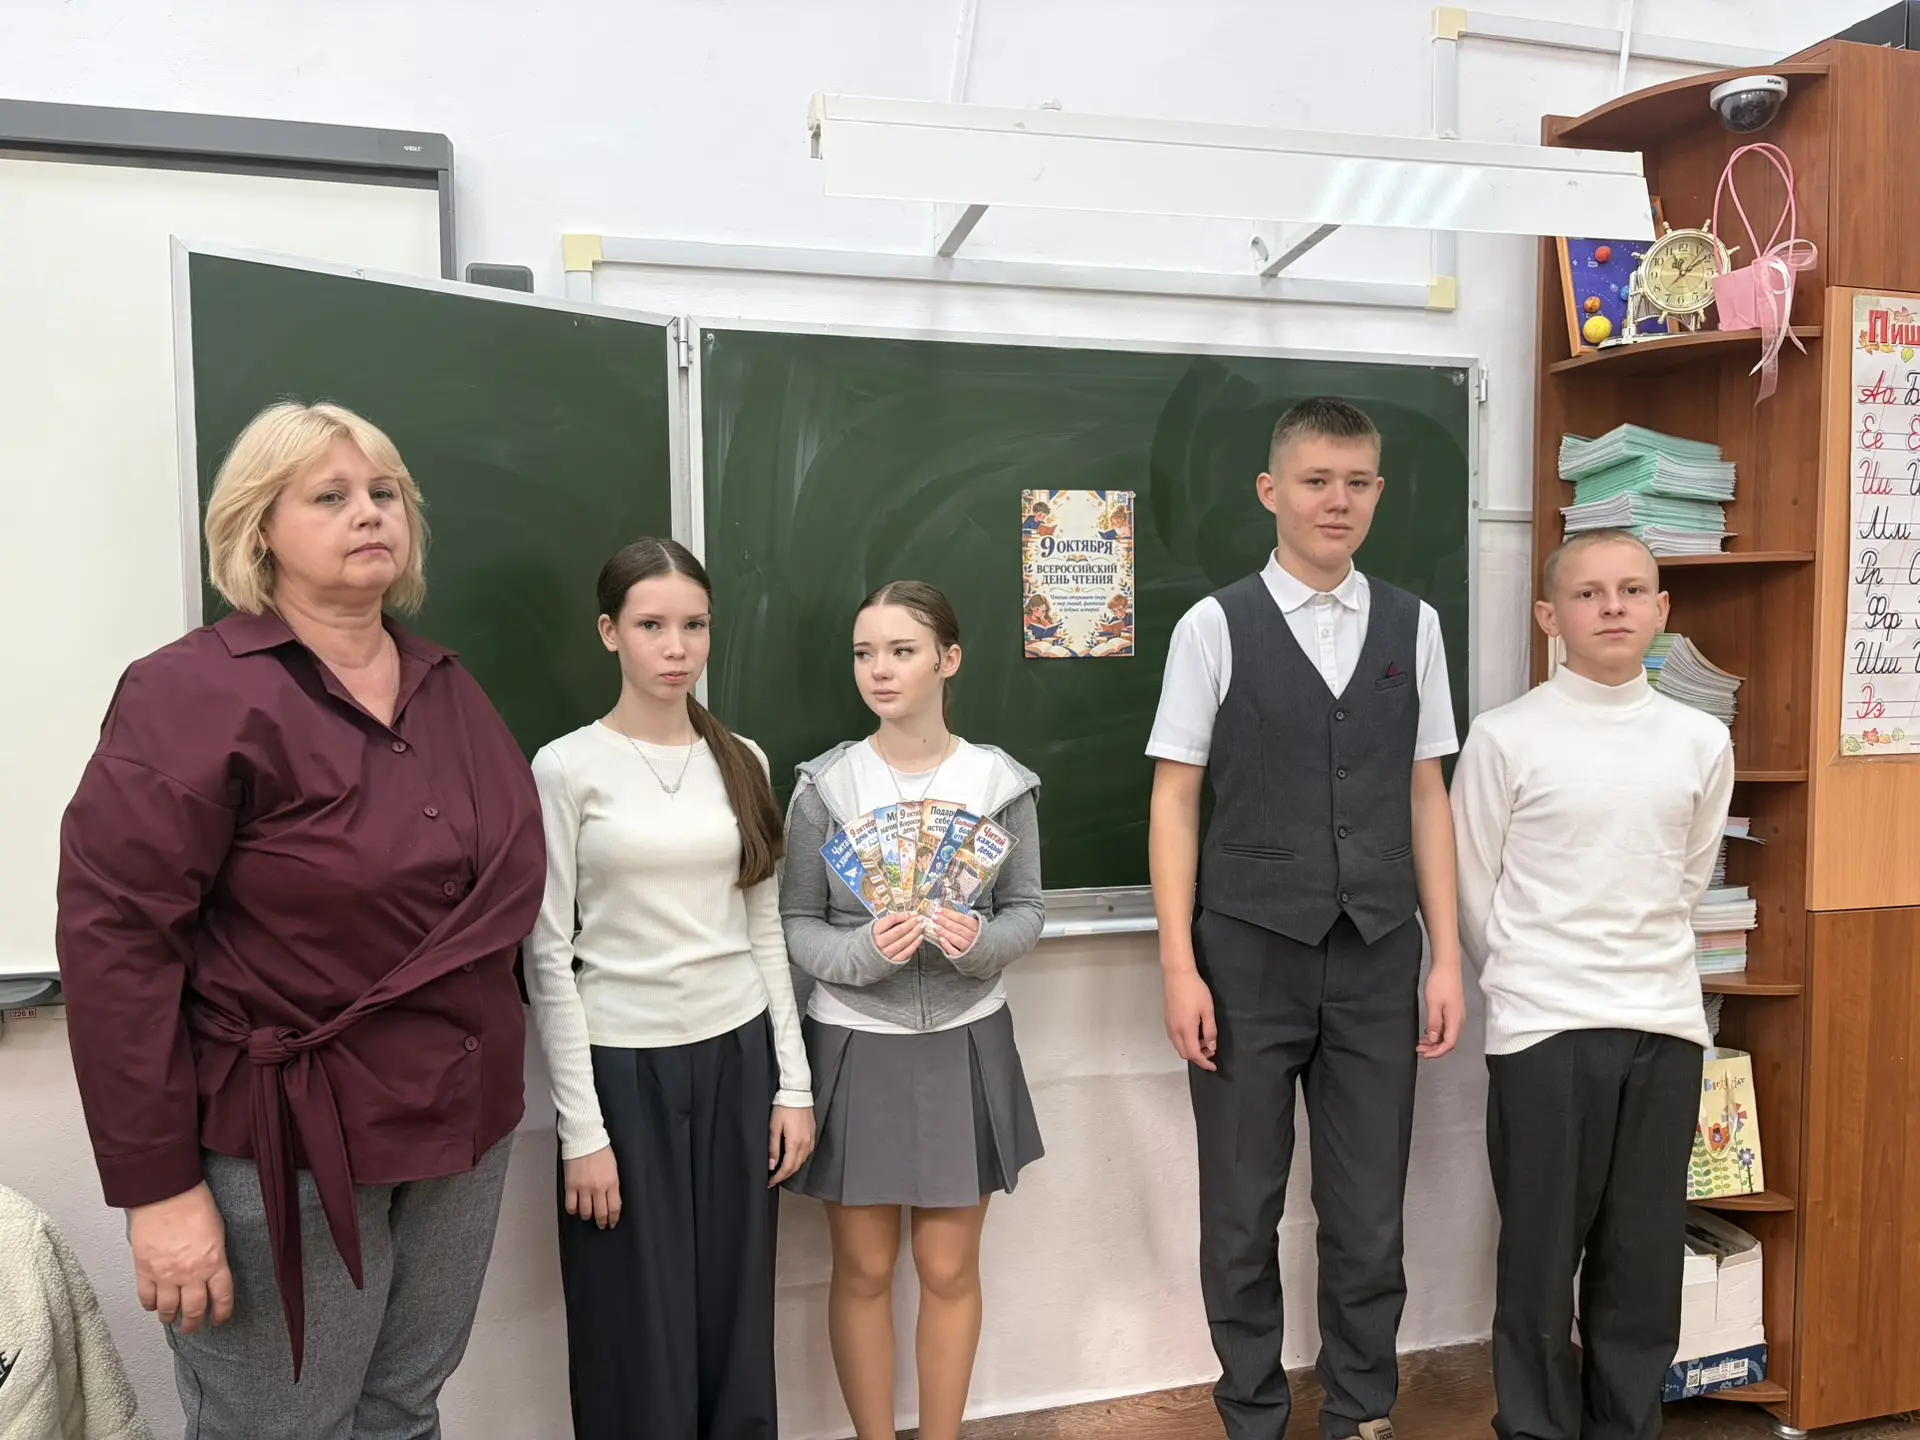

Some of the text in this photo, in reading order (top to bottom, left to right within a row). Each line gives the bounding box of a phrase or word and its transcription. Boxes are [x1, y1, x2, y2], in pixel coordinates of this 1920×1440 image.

[1653, 257, 1664, 266] 10
[1650, 271, 1658, 280] 9
[1653, 284, 1661, 293] 8
[1665, 293, 1672, 303] 7
[1677, 296, 1685, 305] 6
[1862, 415, 1884, 449] Ее
[1040, 536, 1113, 558] 9 ОКТЯБРЯ
[1036, 563, 1118, 574] ВСЕРОССИЙСКИЙ
[1041, 574, 1114, 586] ДЕНЬ ЧТЕНИЯ
[900, 809, 906, 819] 9
[935, 816, 950, 825] себе
[850, 829, 856, 838] 9
[983, 826, 1006, 846] Читай
[831, 838, 851, 855] Чита
[976, 835, 1004, 856] каждый
[977, 846, 998, 862] день!
